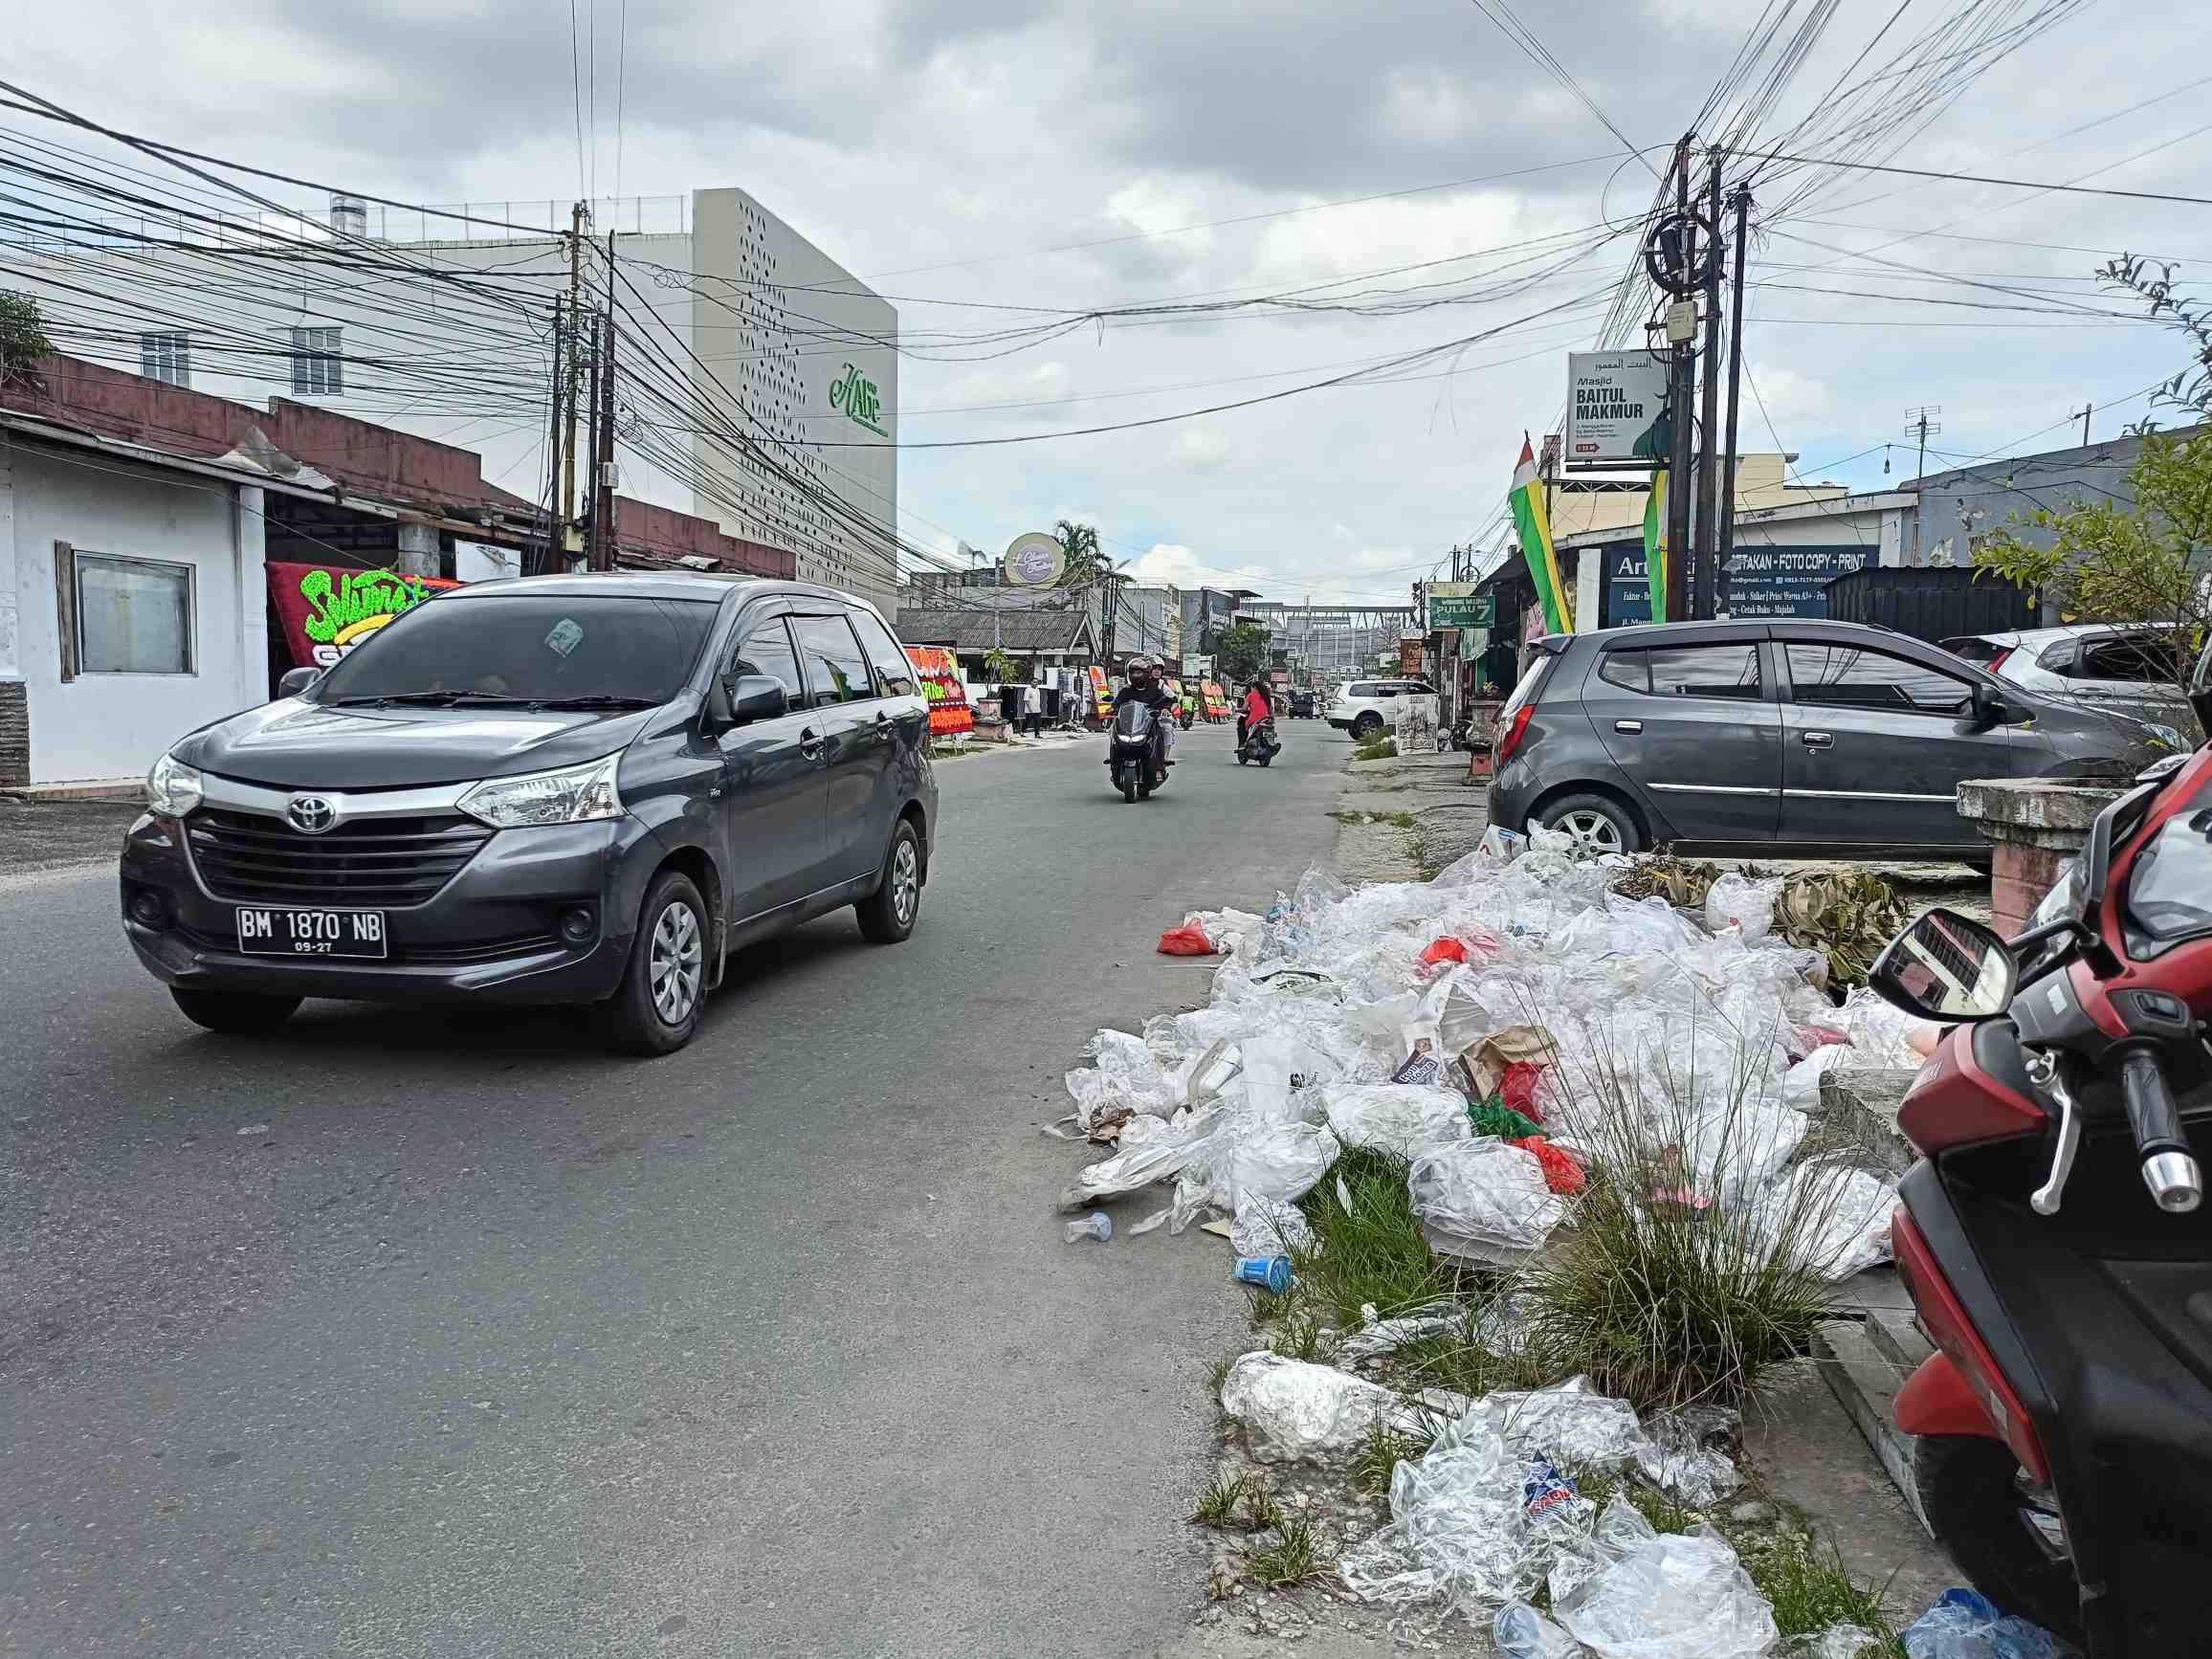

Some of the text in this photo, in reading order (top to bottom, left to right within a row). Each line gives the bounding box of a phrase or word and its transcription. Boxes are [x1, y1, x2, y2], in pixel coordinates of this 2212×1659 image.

[1577, 376, 1612, 387] Masjid
[1576, 387, 1626, 404] BAITUL
[1576, 404, 1644, 420] MAKMUR
[1779, 553, 1804, 570] FOTO
[1805, 553, 1831, 570] COPY
[1838, 553, 1867, 570] PRINT
[1436, 605, 1491, 621] PULAU 7
[241, 910, 382, 941] BM 1870 NB
[295, 941, 333, 953] 09-27
